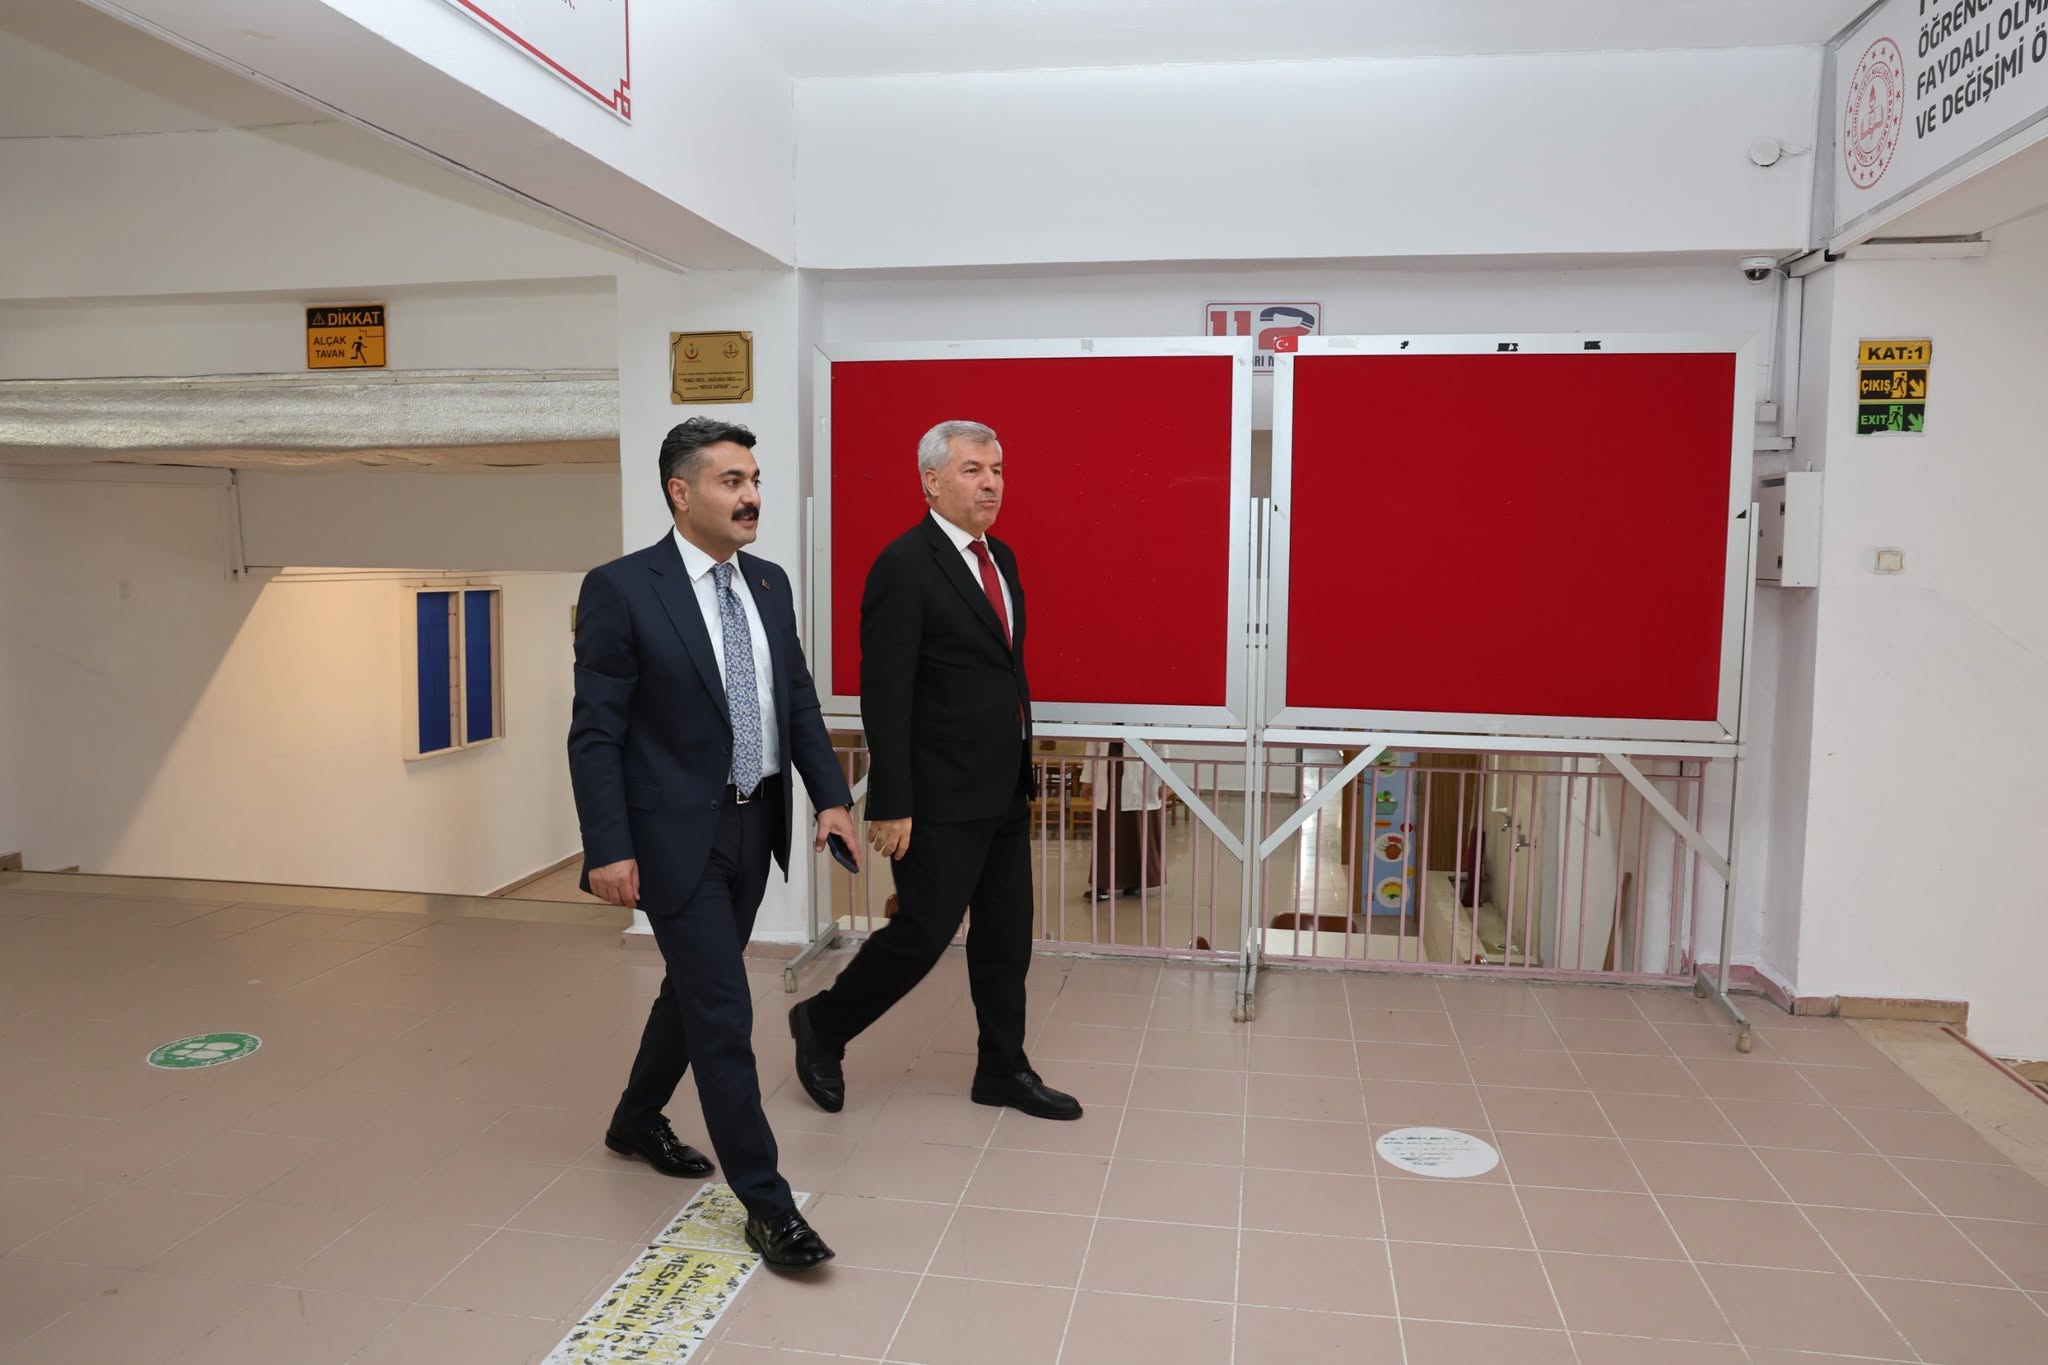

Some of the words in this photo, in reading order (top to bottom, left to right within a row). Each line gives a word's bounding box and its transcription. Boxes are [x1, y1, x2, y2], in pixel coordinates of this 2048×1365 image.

[1917, 22, 1990, 101] FAYDALI
[1998, 0, 2048, 41] OLM
[1916, 104, 1936, 139] VE
[1942, 36, 2024, 124] DEĞİŞİMİ
[327, 308, 380, 326] DİKKAT
[313, 336, 347, 346] ALÇAK
[315, 349, 345, 359] TAVAN
[1868, 346, 1923, 360] KAT:1
[1861, 379, 1891, 394] ÇIKIŞ
[1861, 415, 1888, 425] EXIT
